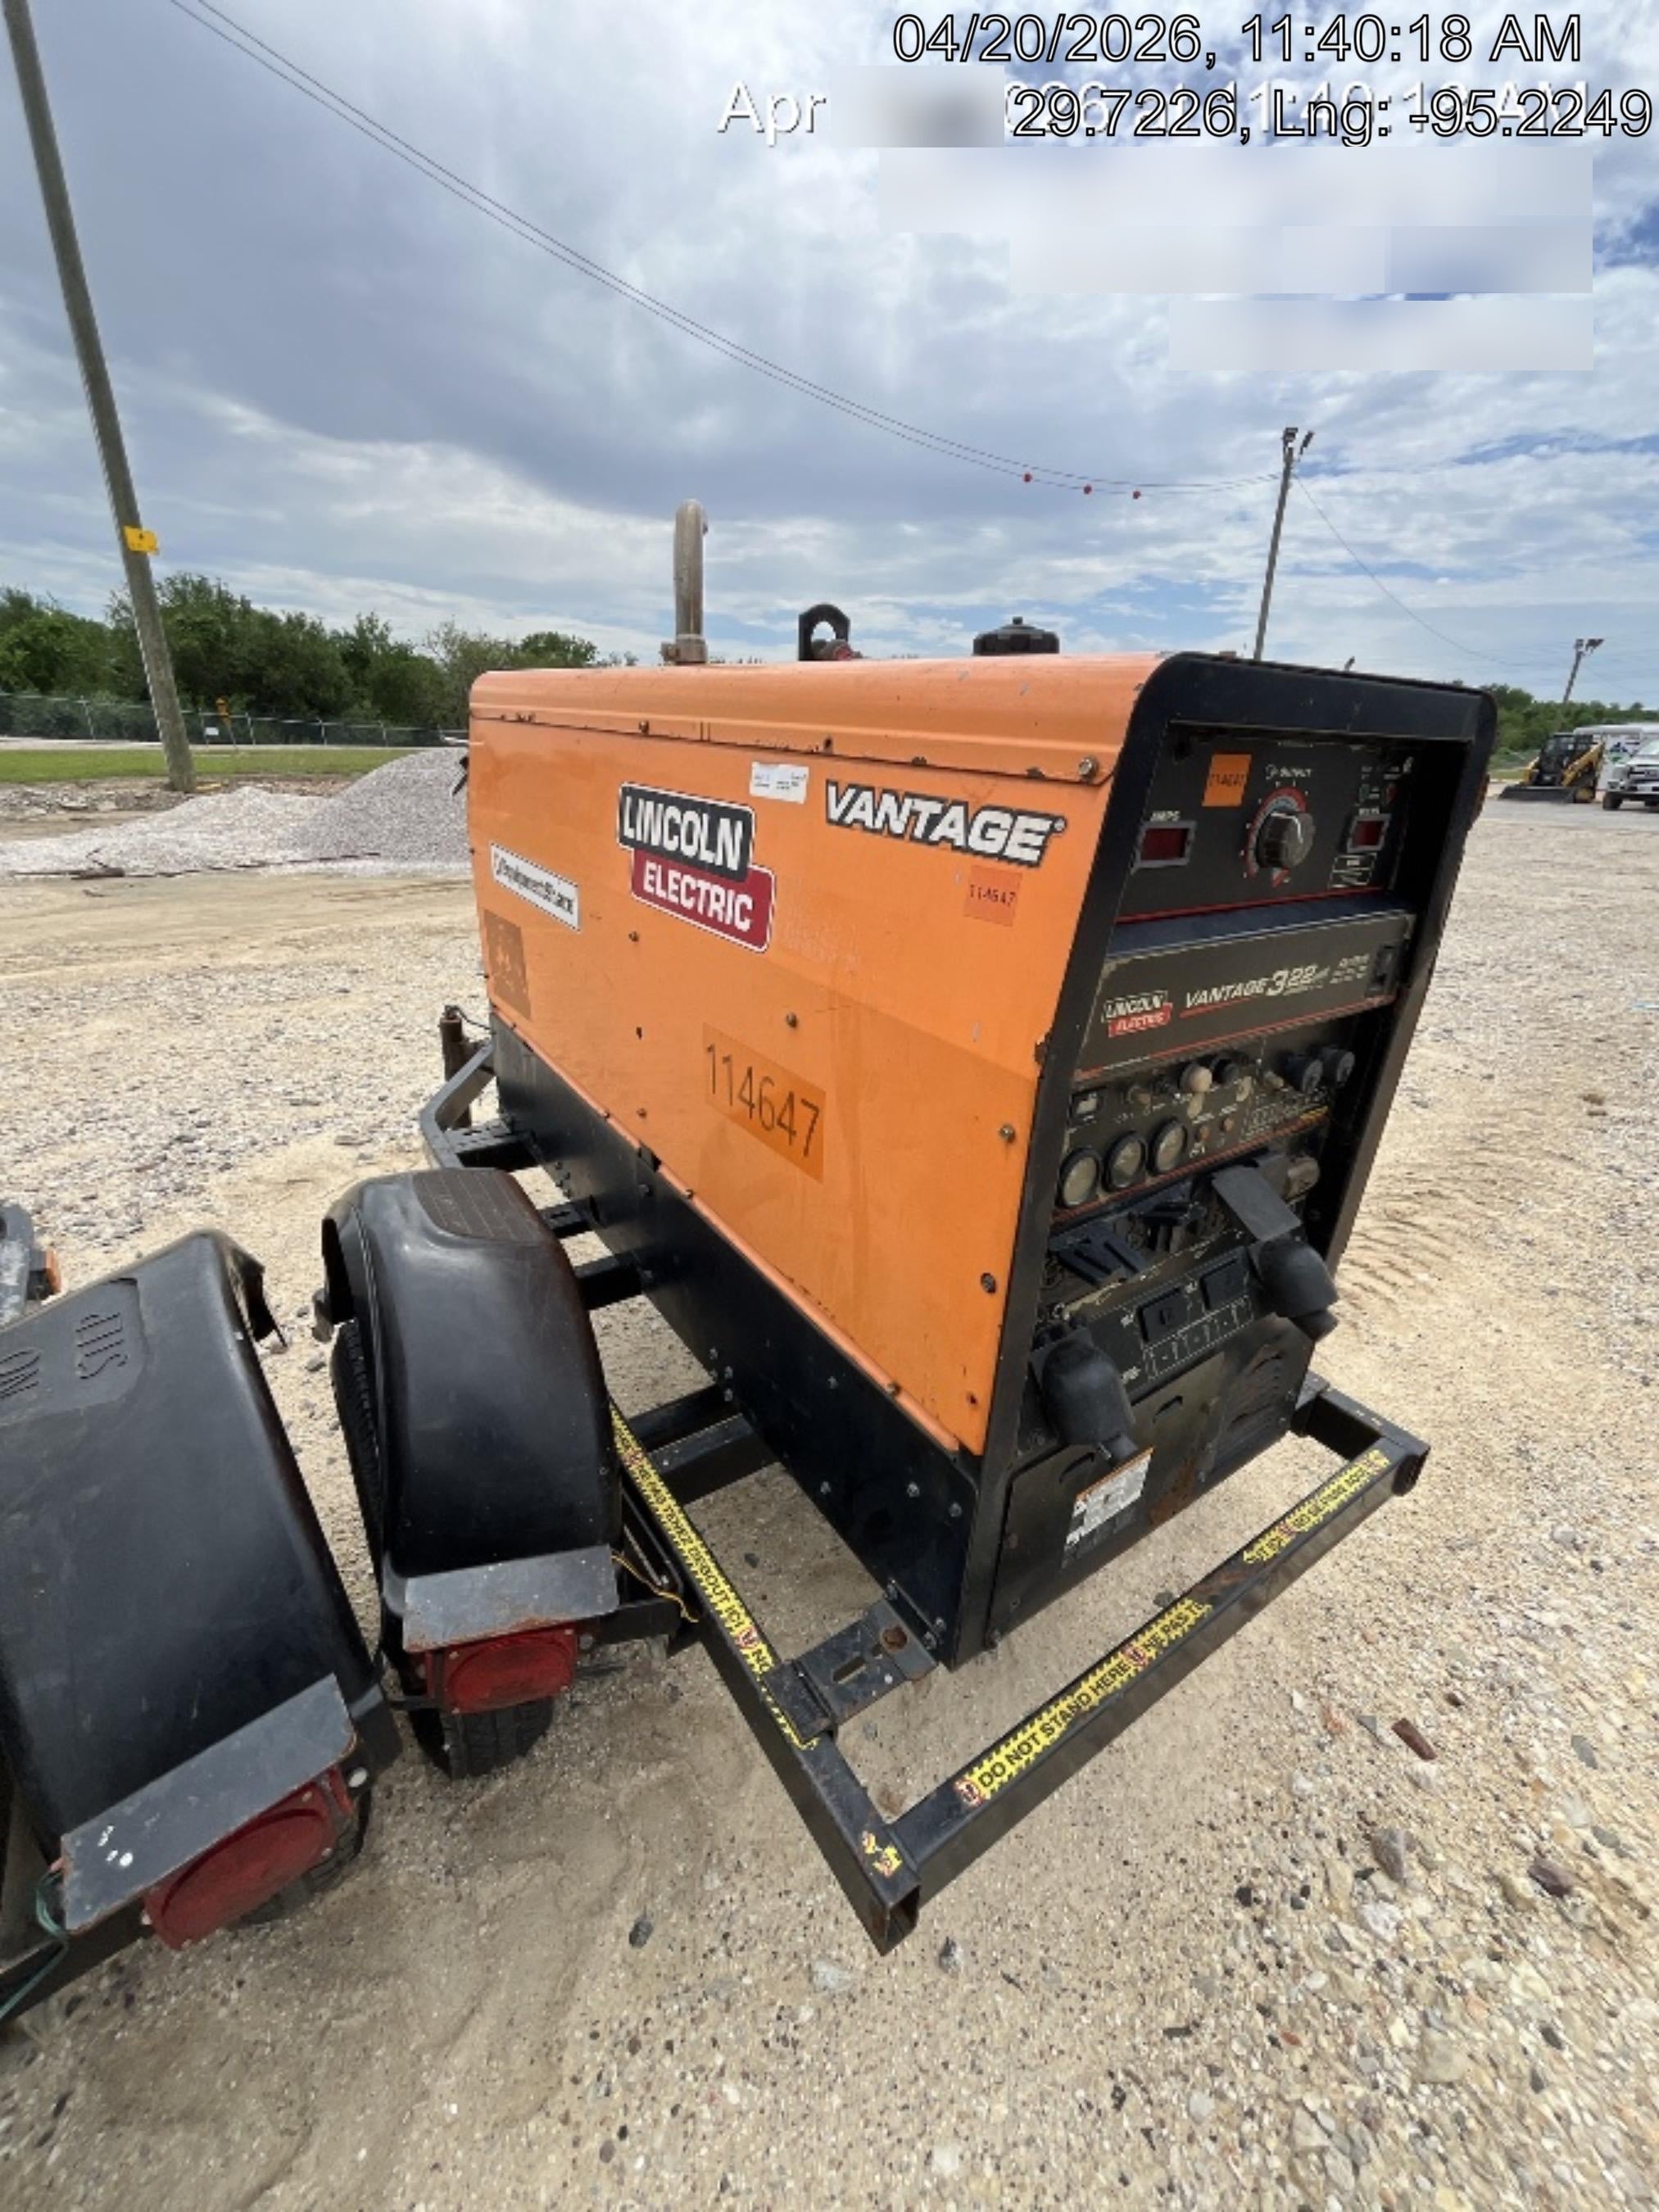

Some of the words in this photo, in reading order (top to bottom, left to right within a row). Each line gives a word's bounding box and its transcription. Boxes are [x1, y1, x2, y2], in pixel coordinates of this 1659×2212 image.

[623, 796, 744, 872] LINCOLN
[826, 780, 1052, 866] VANTAGE
[642, 860, 754, 933] ELECTRIC
[1186, 977, 1269, 1009] VANTAGE
[706, 1043, 821, 1158] 114647
[977, 1761, 1007, 1788] DO
[1007, 1734, 1041, 1767] NOT
[1040, 1691, 1093, 1738] STAND
[1090, 1661, 1131, 1697] HERE
